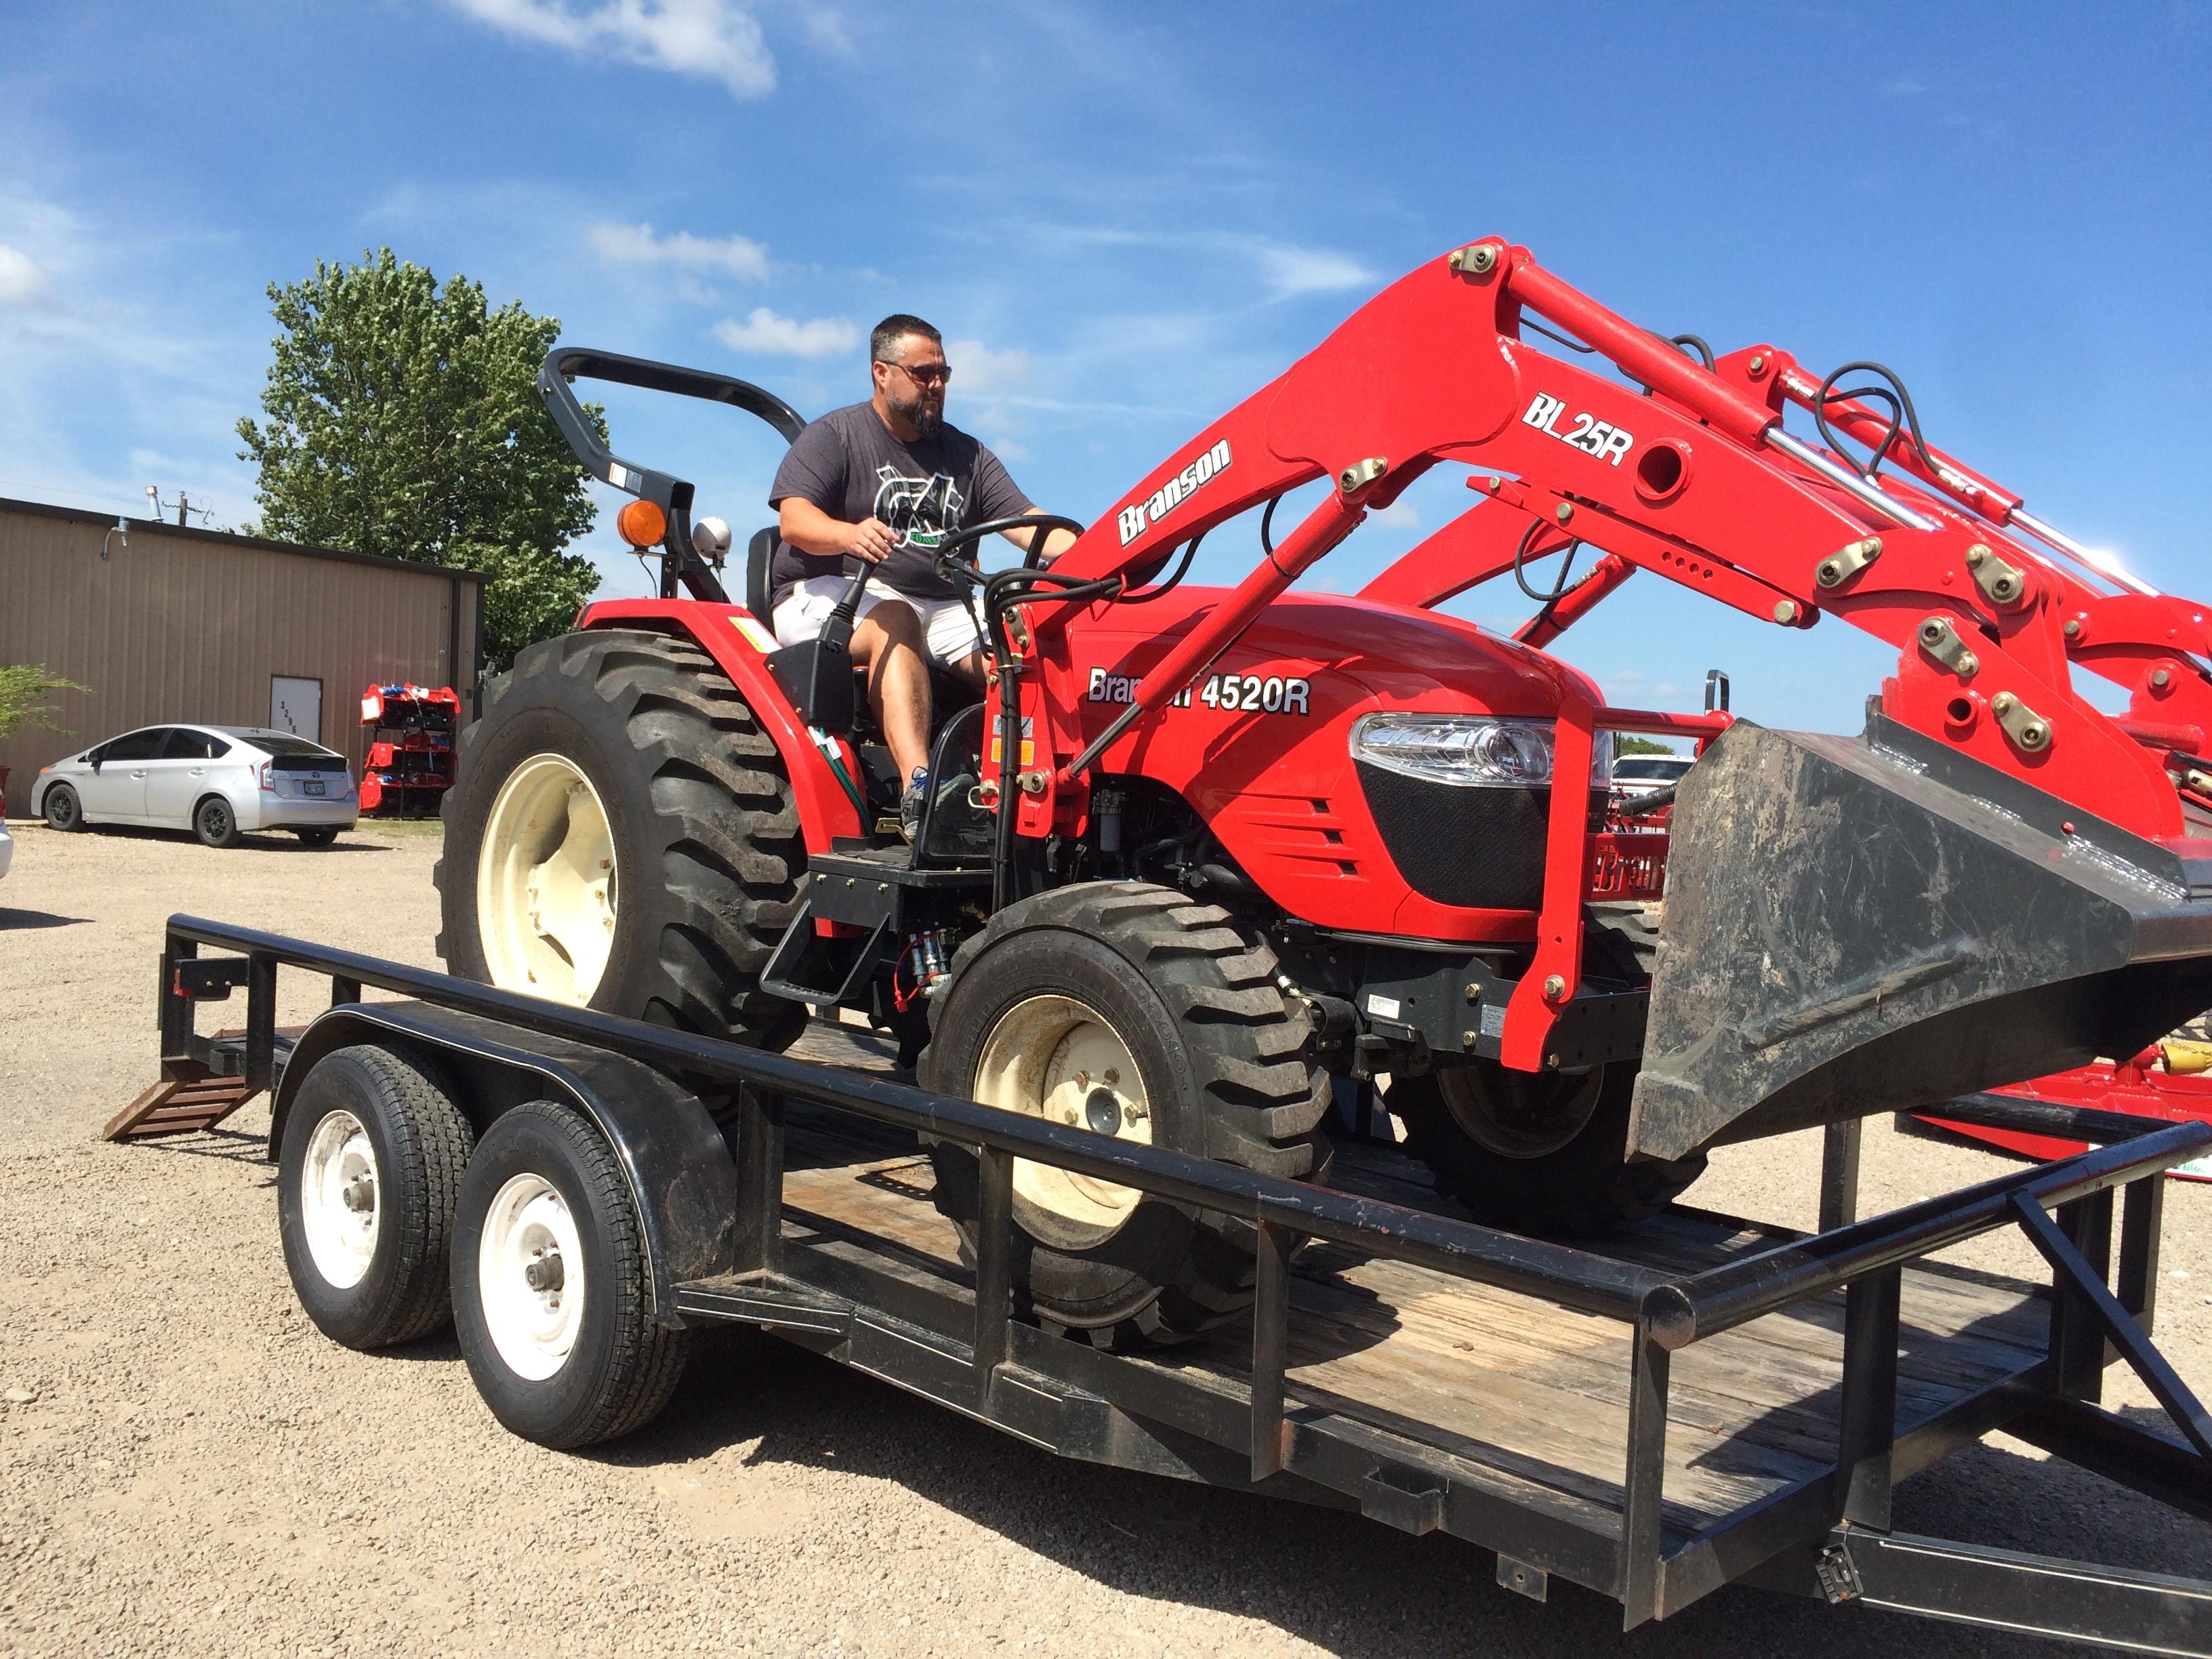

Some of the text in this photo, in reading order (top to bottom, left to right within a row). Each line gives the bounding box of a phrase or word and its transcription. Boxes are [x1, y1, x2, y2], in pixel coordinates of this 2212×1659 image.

[1118, 438, 1232, 548] Branson
[1088, 668, 1309, 714] Brann 4520R
